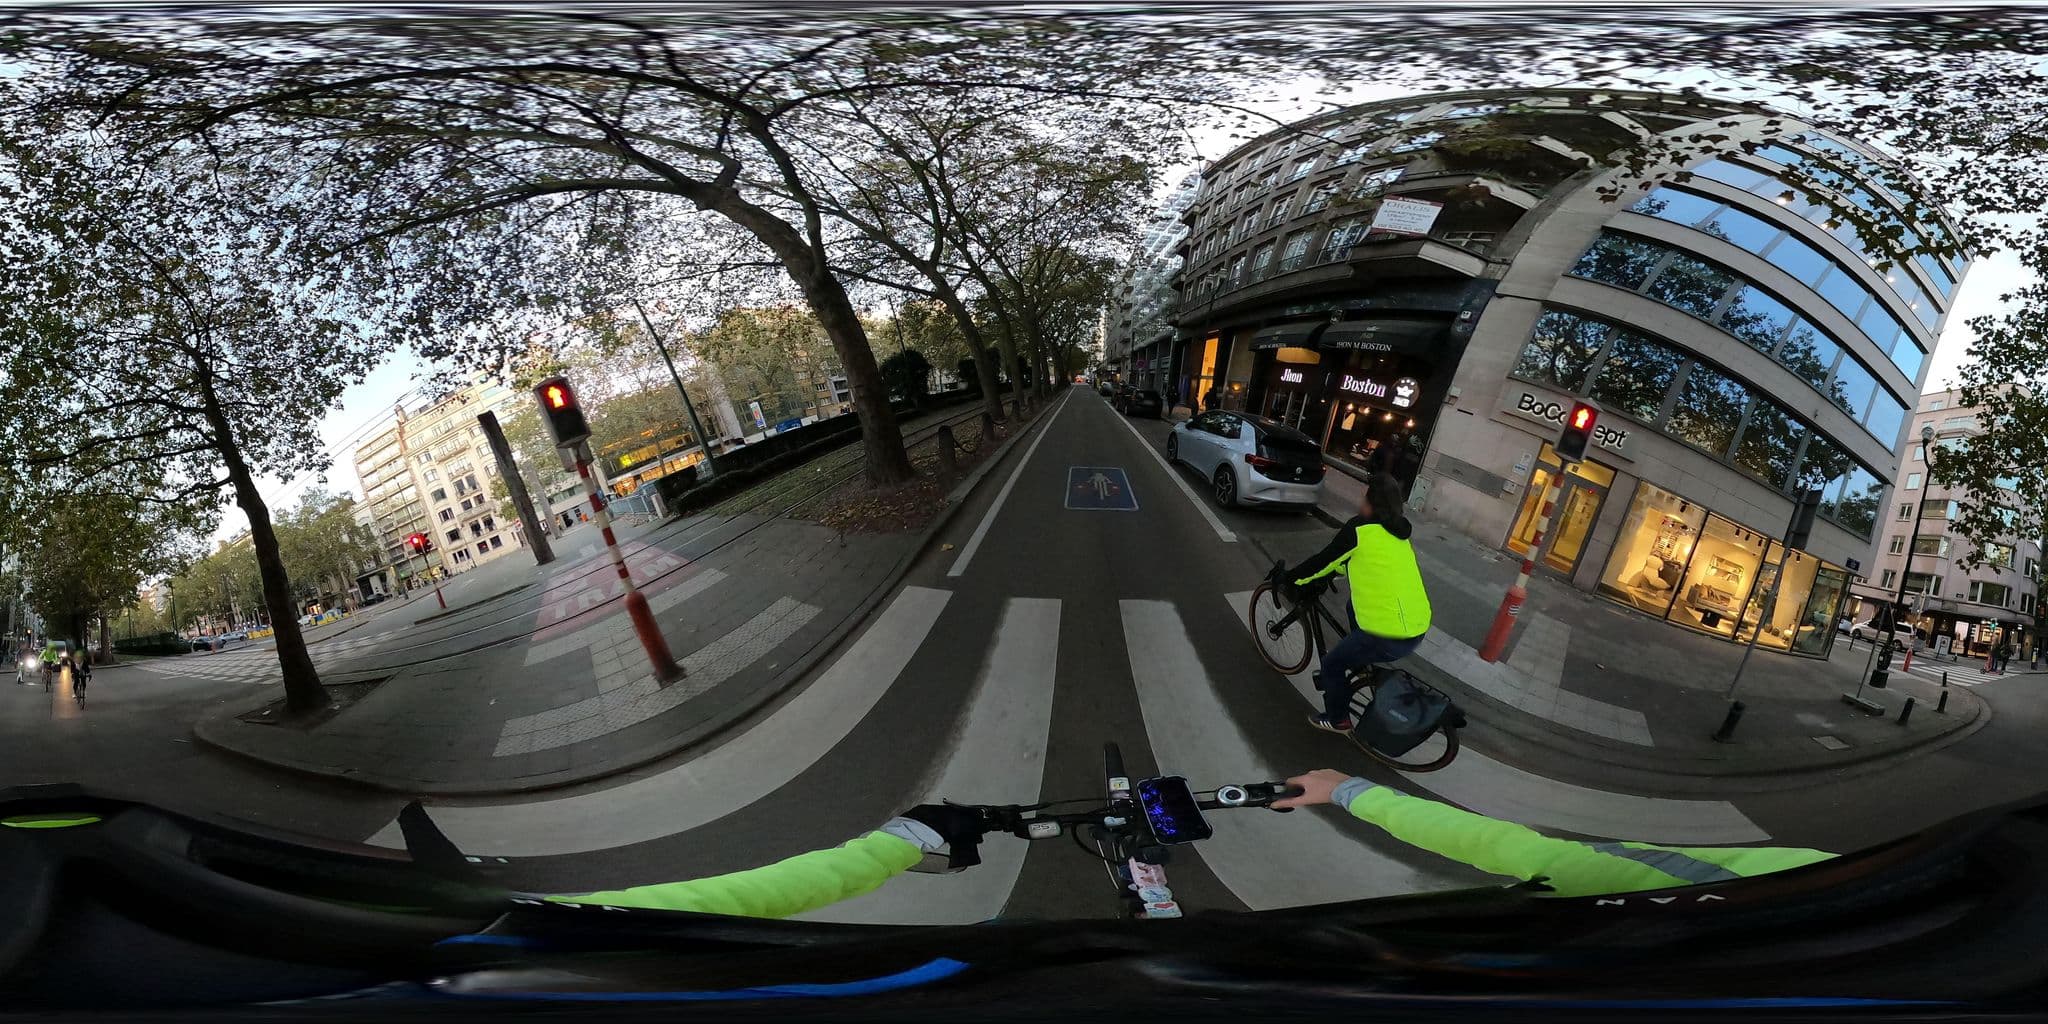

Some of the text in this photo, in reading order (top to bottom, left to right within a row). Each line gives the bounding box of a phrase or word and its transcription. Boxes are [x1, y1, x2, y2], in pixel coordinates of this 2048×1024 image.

[1361, 342, 1392, 351] BOSTON
[1280, 368, 1303, 383] Jhon
[1340, 374, 1386, 397] Boston
[1518, 392, 1626, 448] BoCept
